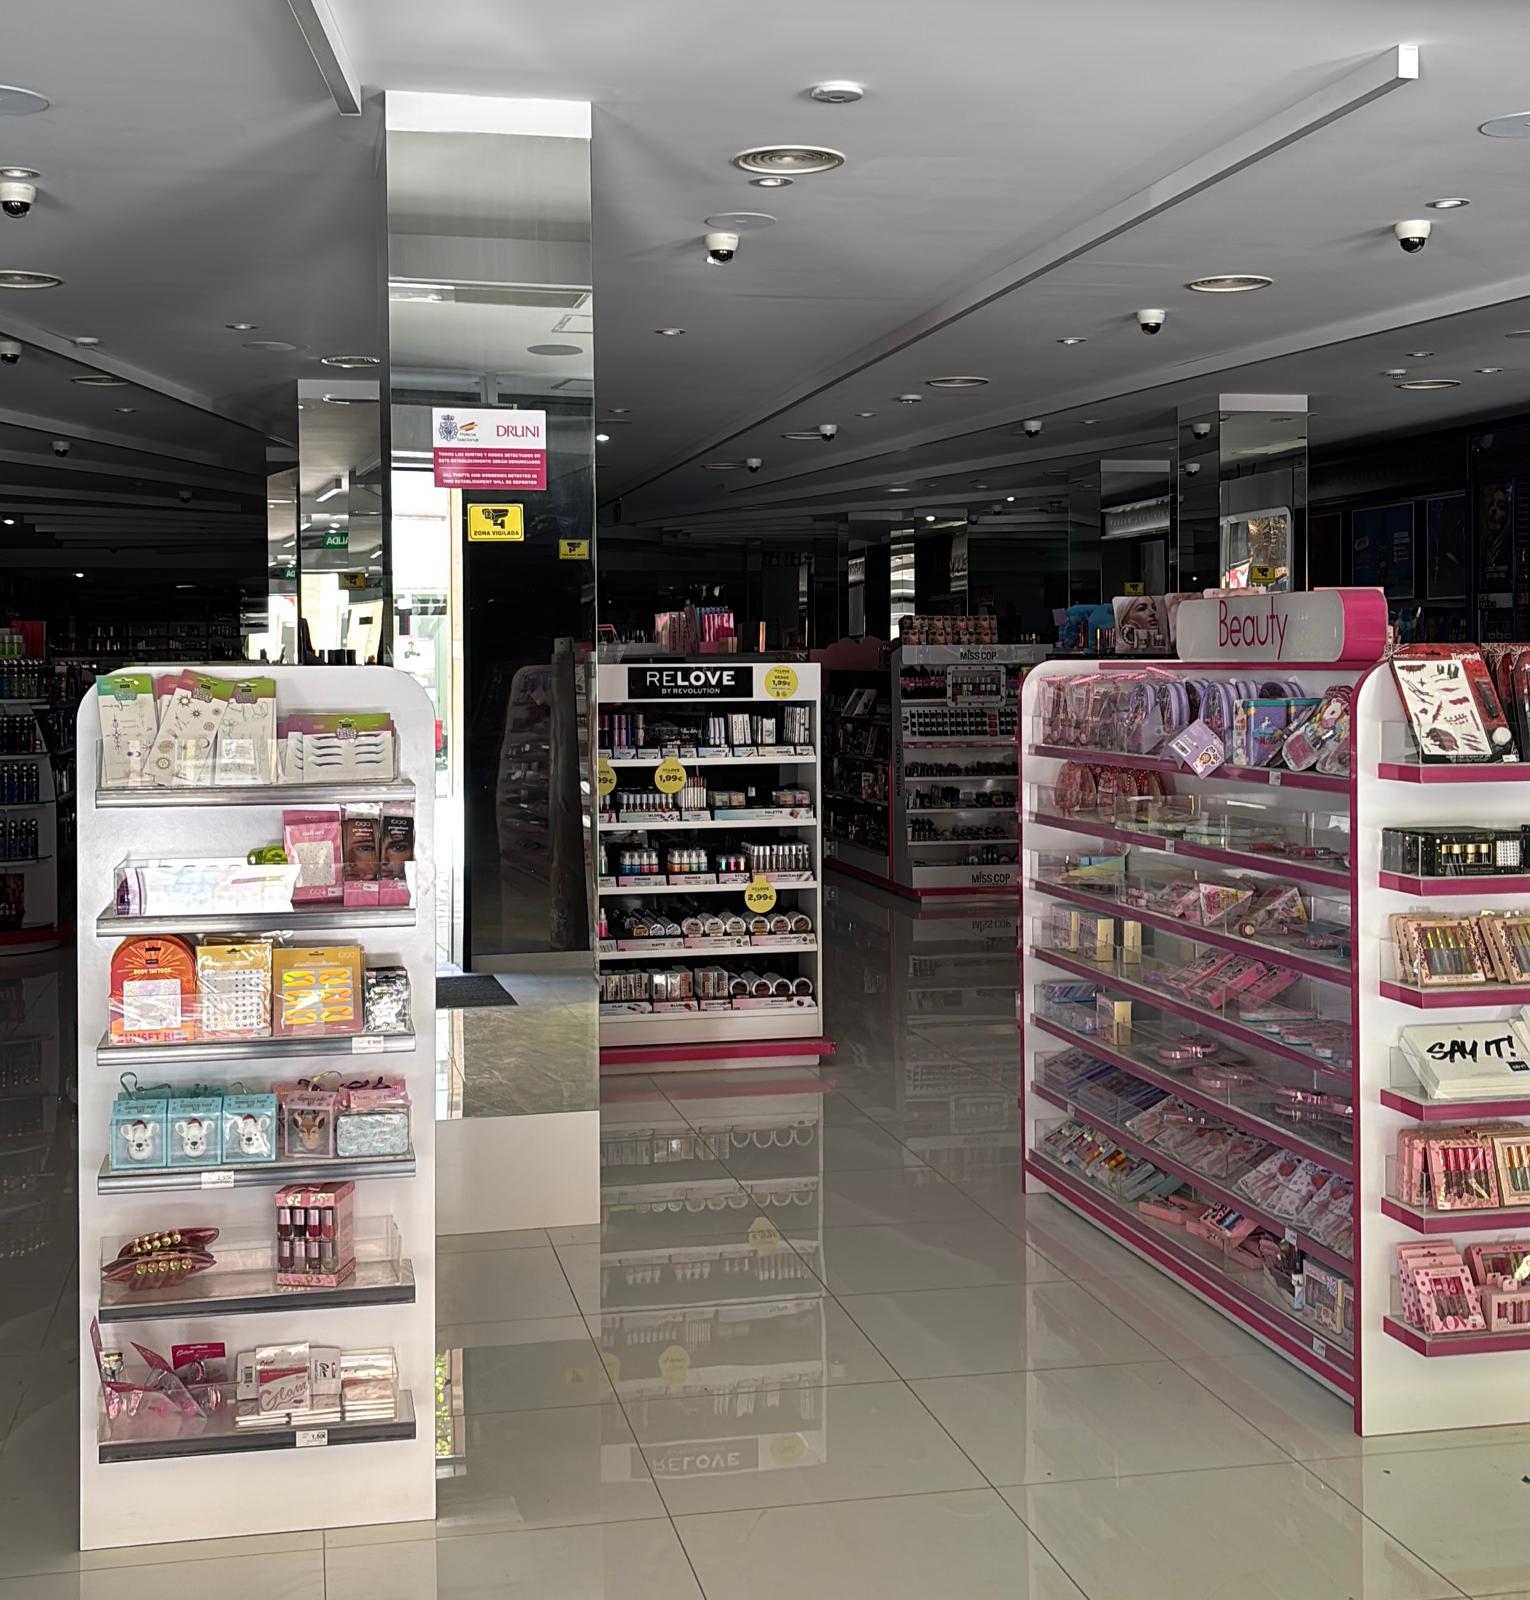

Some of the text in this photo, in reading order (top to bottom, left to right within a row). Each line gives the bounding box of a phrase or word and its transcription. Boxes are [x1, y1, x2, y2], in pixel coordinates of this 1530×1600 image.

[496, 425, 540, 437] DRUNI
[1219, 596, 1288, 660] Beauty
[960, 650, 997, 660] MISS COP
[646, 670, 735, 686] RELOVE
[659, 775, 683, 783] 1,99€
[971, 872, 1011, 884] MISS COP
[747, 893, 774, 902] 2,99€
[133, 967, 149, 975] BODY
[1426, 1035, 1516, 1063] SAY IT!
